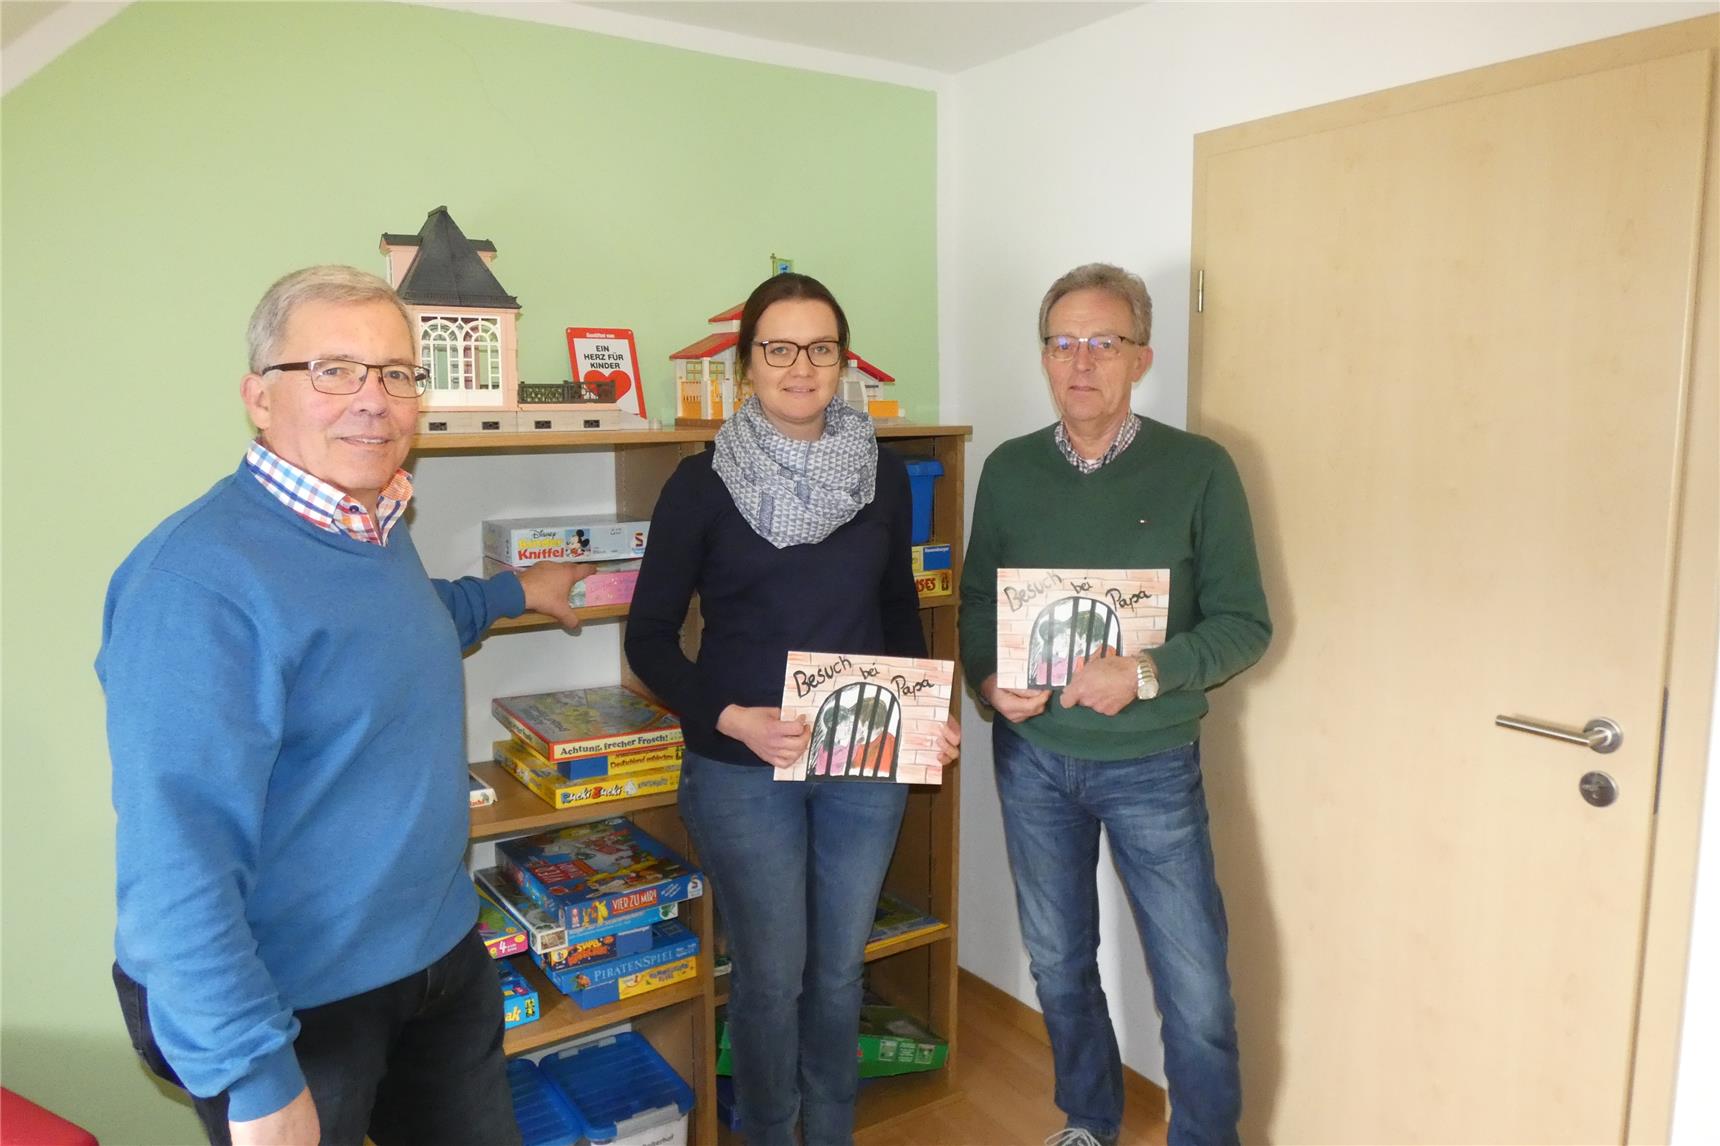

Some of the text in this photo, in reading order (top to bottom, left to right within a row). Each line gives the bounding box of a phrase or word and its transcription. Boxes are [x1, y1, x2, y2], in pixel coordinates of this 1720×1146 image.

[583, 351, 624, 361] HERZ FÜR
[595, 345, 610, 353] EIN
[528, 529, 557, 540] Disney
[518, 547, 565, 561] Kniffel
[1003, 571, 1152, 613] Besuch bei Papa
[793, 655, 935, 700] Besuch bei Papa
[560, 734, 668, 756] Achtung, frecher Frosch!
[612, 897, 630, 911] VIER
[629, 893, 640, 907] ZU
[499, 941, 507, 954] 4
[593, 950, 673, 981] PIRATENSPIEL
